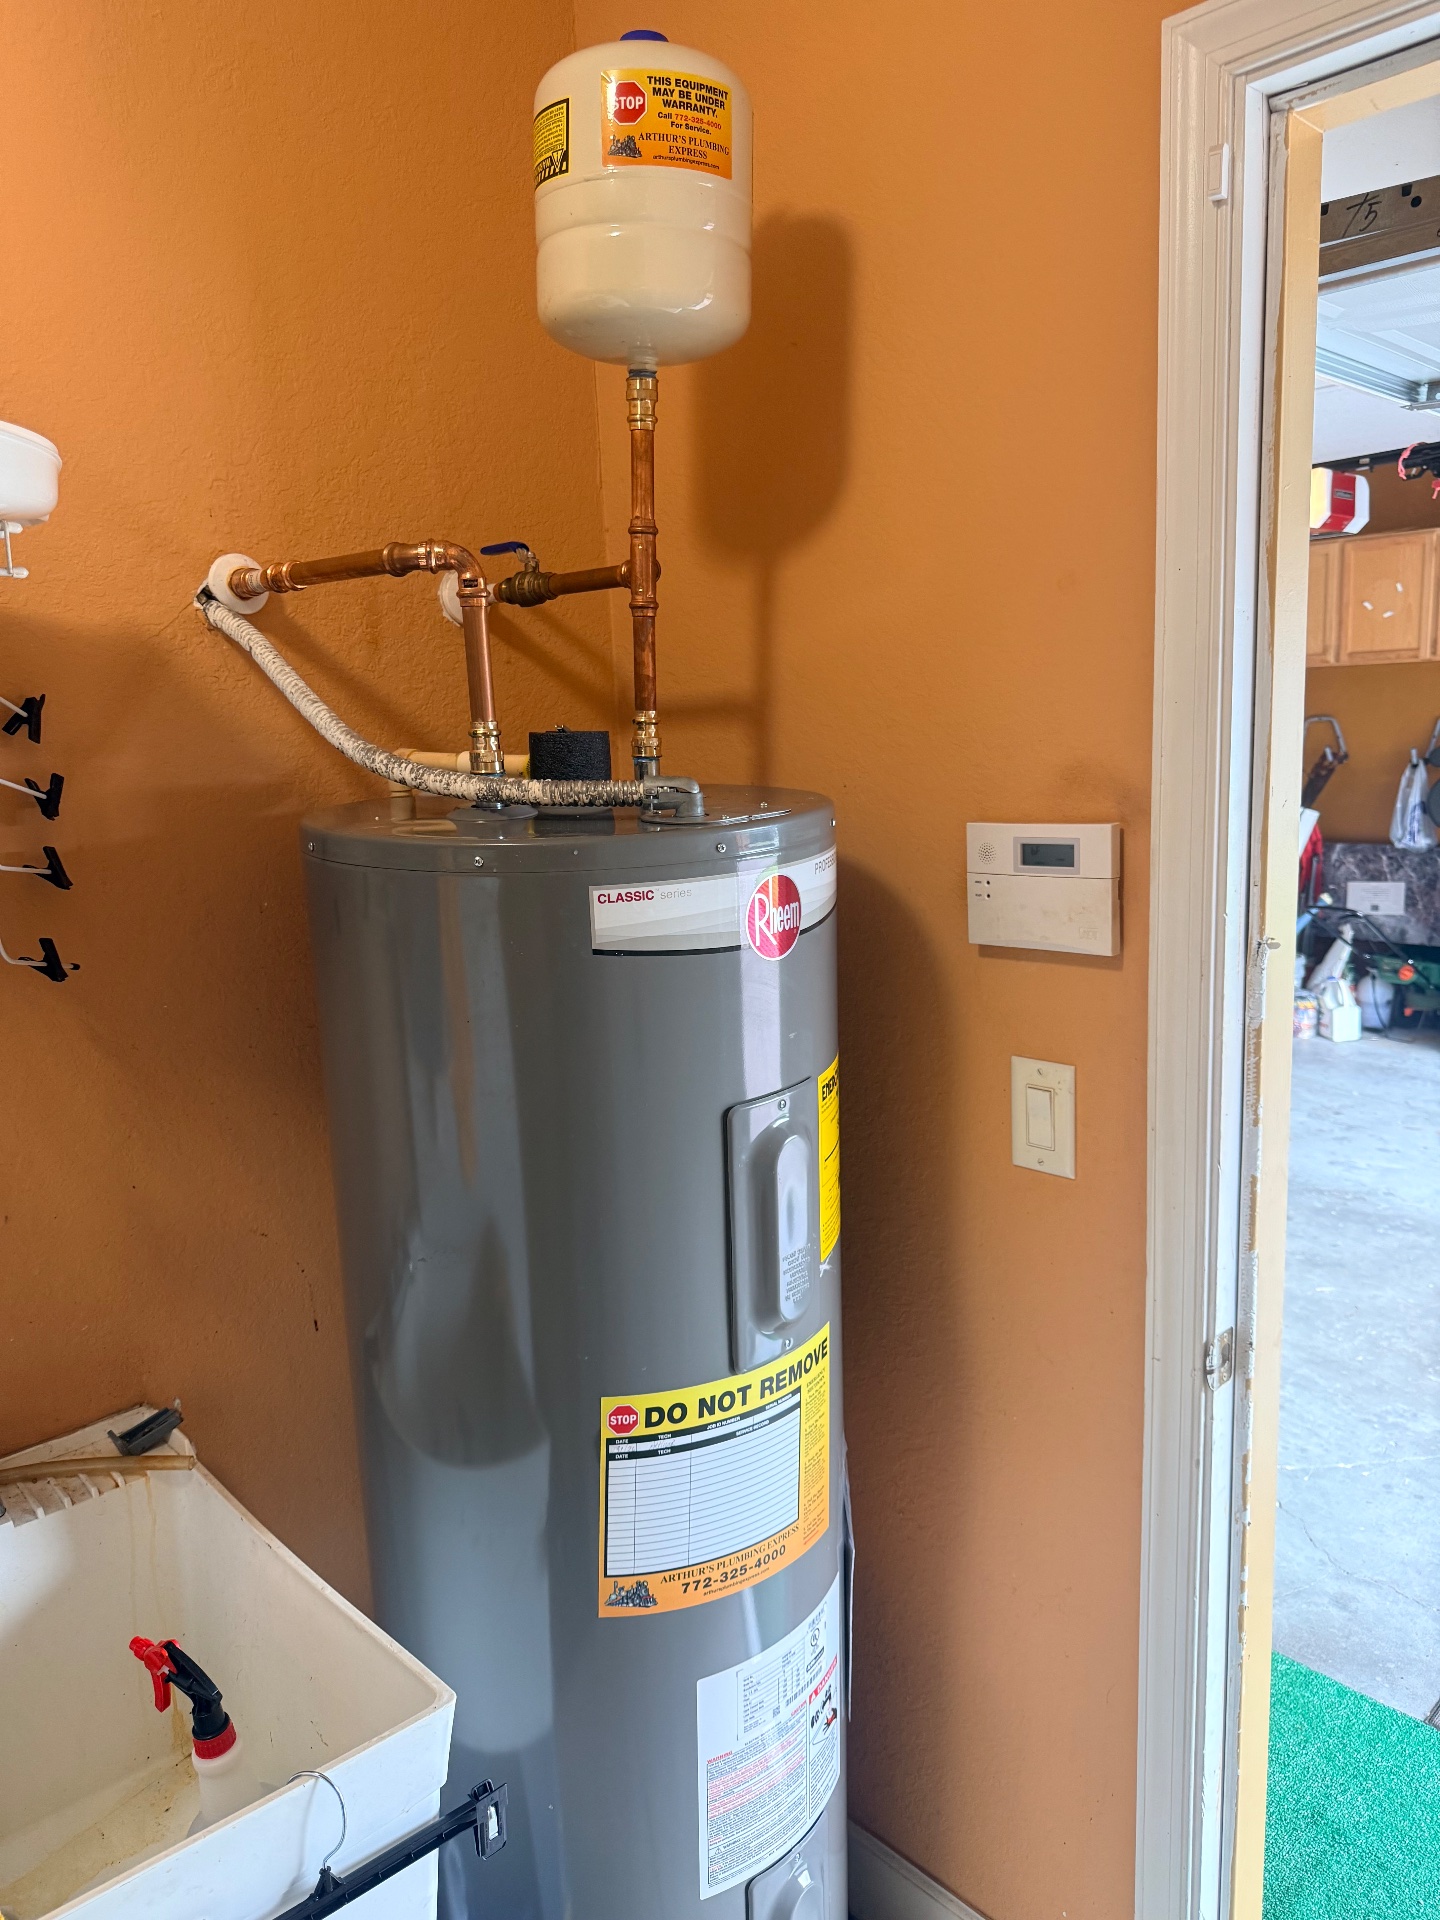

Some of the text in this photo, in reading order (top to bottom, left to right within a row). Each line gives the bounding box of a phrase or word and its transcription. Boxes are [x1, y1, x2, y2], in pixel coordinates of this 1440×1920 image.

[646, 76, 728, 101] THIS EQUIPMENT
[652, 87, 725, 110] MAY BE UNDER
[614, 95, 644, 110] STOP
[662, 98, 718, 118] WARRANTY.
[657, 111, 722, 130] Call 772-325-4000
[670, 121, 712, 135] For Service.
[638, 132, 730, 156] ARTHUR'S PLUMBING
[668, 145, 708, 160] EXPRESS
[597, 888, 692, 904] CLASSIC series
[754, 877, 800, 947] Rheem
[645, 1336, 828, 1429] DO NOT REMOVE
[609, 1414, 637, 1426] STOP
[722, 1415, 741, 1426] NUMBER
[660, 1524, 800, 1584] ARTHUR'S PLUMBING EXPRESS
[682, 1544, 786, 1594] 772-325-4000
